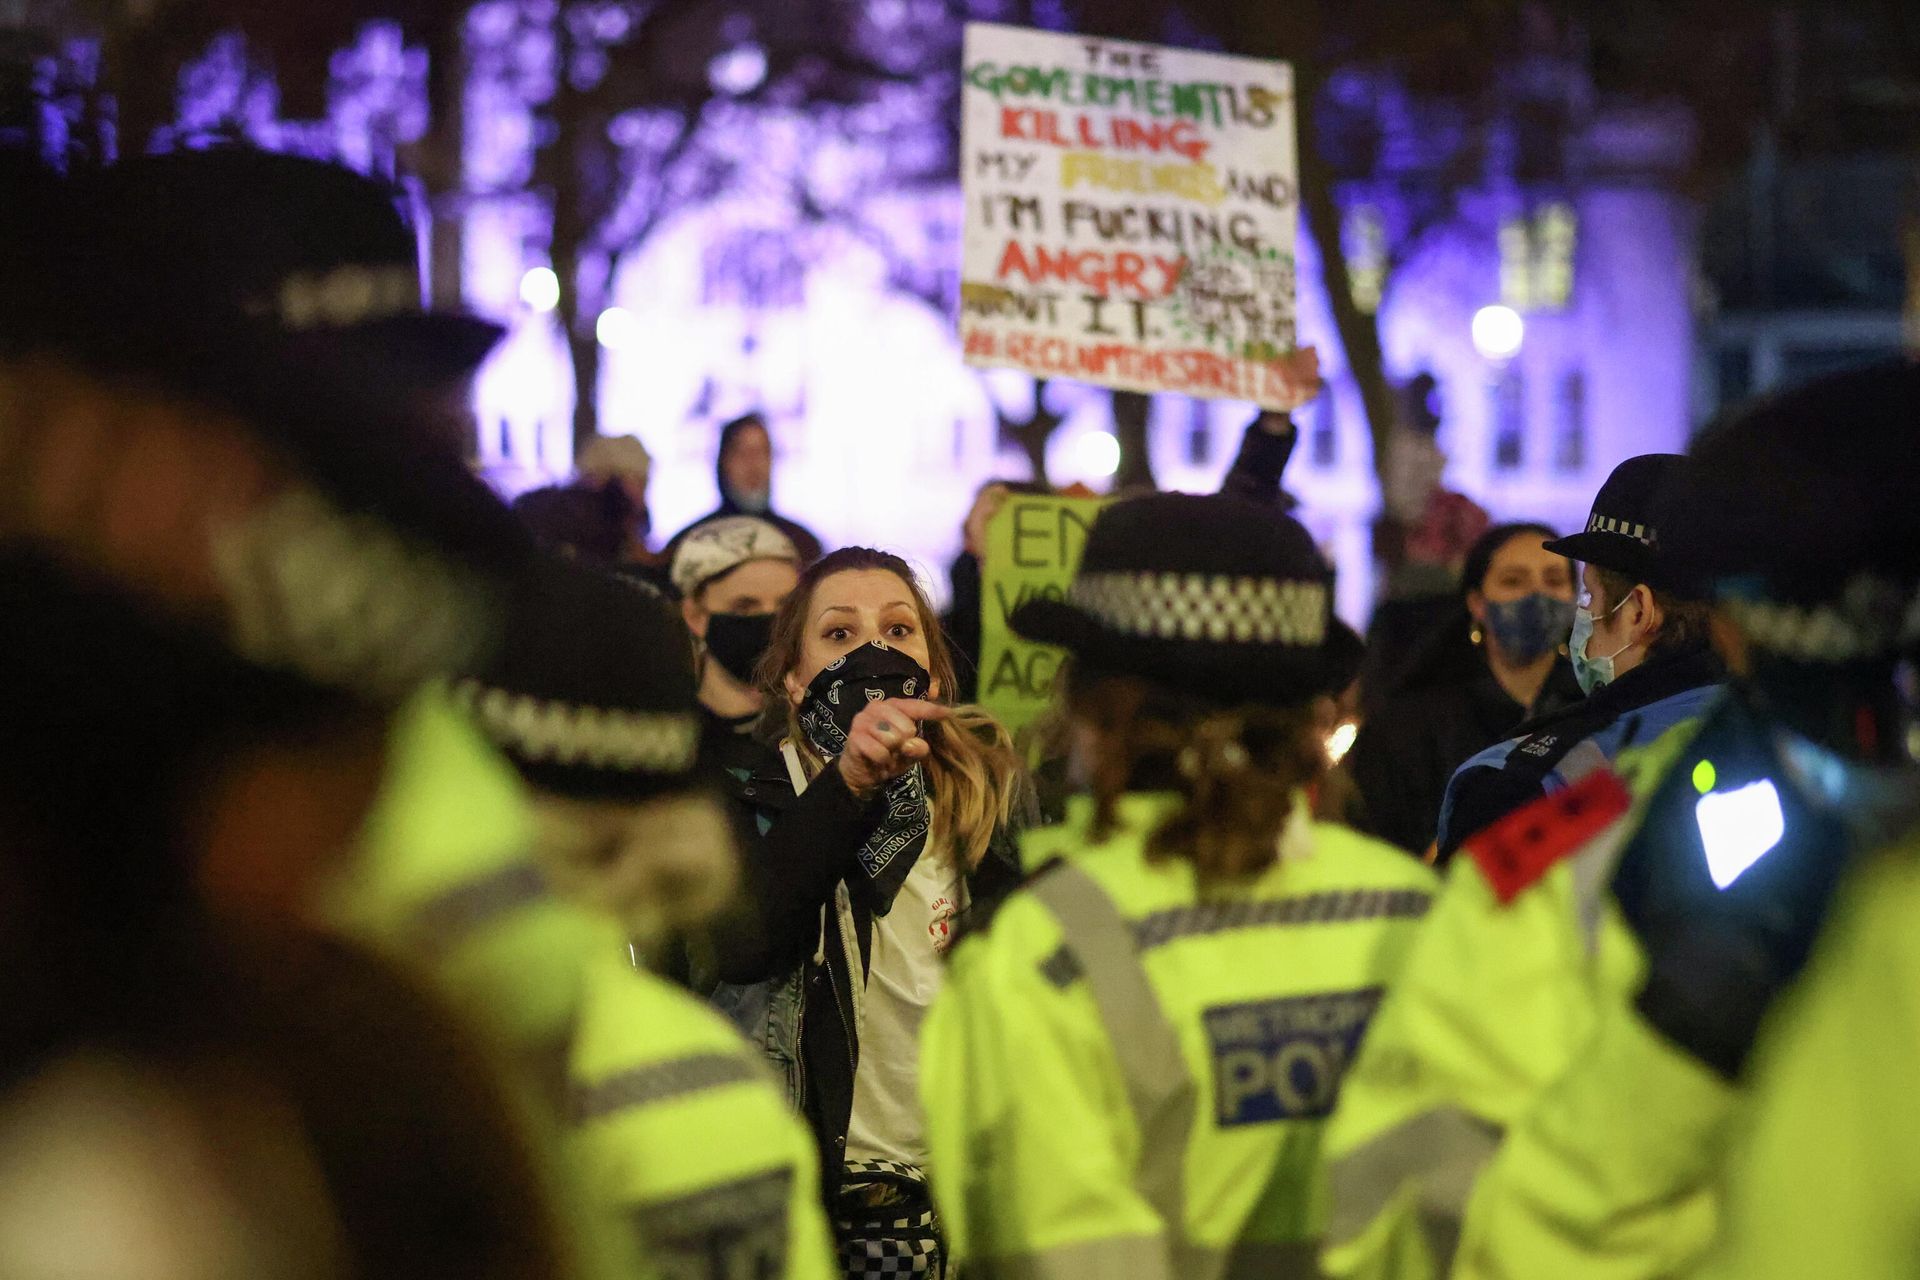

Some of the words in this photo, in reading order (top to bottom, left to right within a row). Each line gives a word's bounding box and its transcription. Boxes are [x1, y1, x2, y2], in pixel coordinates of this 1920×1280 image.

[1084, 45, 1161, 73] THE
[1000, 106, 1209, 163] KILLING
[976, 152, 1036, 180] MY
[981, 194, 1043, 231] I'M
[1062, 200, 1261, 253] FUCKING
[997, 238, 1189, 298] ANGRY
